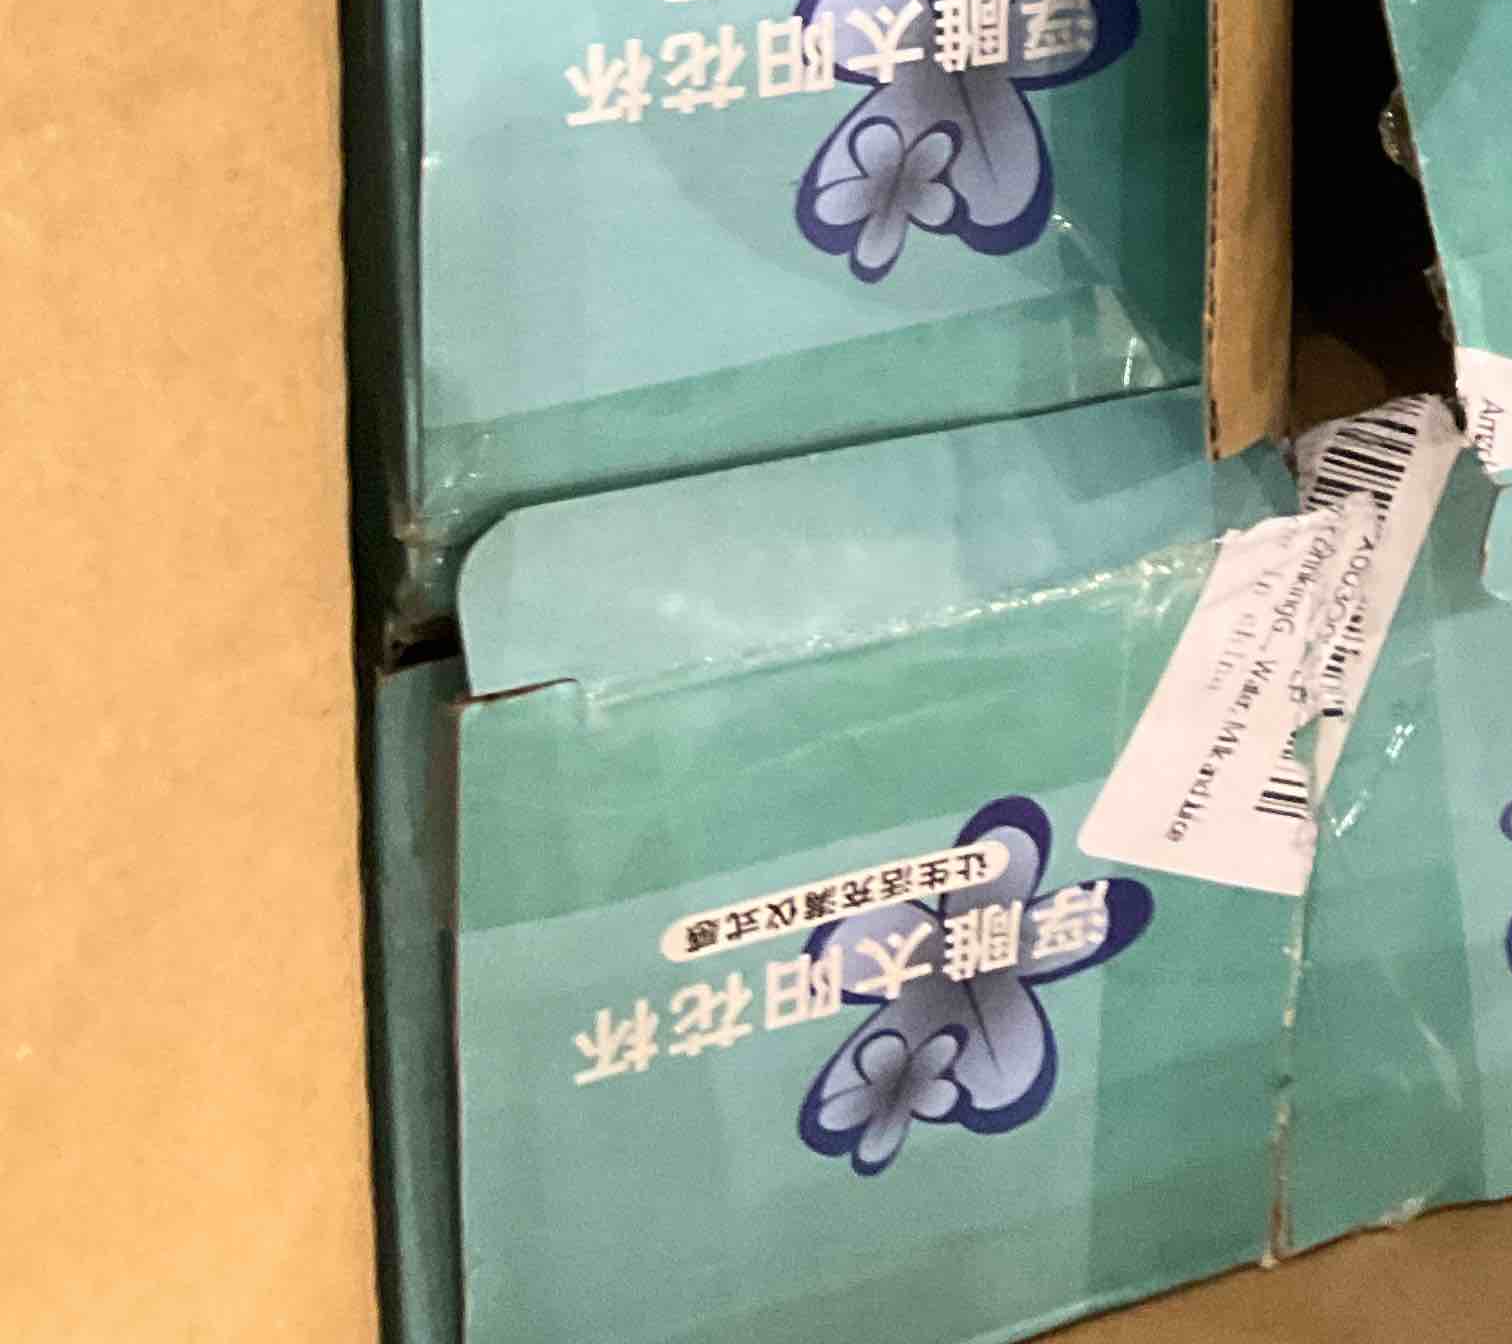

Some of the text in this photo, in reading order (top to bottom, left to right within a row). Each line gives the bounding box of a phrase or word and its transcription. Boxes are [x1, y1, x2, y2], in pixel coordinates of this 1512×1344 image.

[685, 850, 987, 954] 让生活充满仪式感
[574, 879, 1110, 1086] 浮雕太阳花杯
